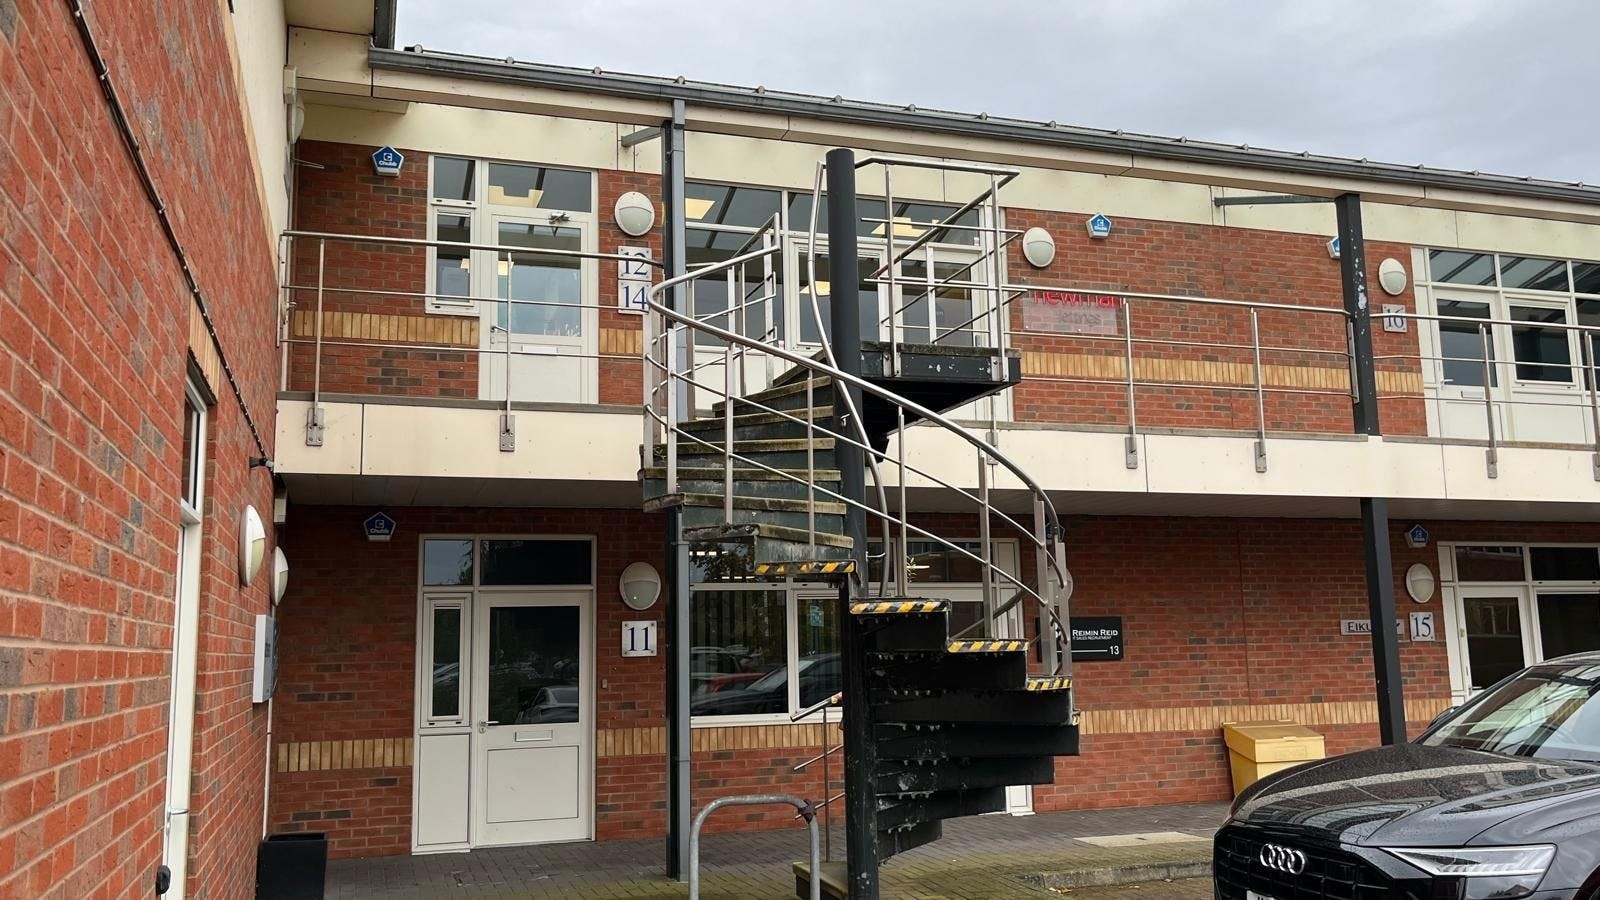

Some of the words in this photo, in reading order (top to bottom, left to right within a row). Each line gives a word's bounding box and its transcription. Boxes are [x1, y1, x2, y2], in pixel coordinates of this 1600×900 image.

[623, 251, 648, 276] 12
[622, 285, 648, 310] 14
[1386, 308, 1404, 329] 16
[1414, 616, 1432, 637] 15
[627, 626, 651, 652] 11
[1109, 645, 1120, 655] 13
